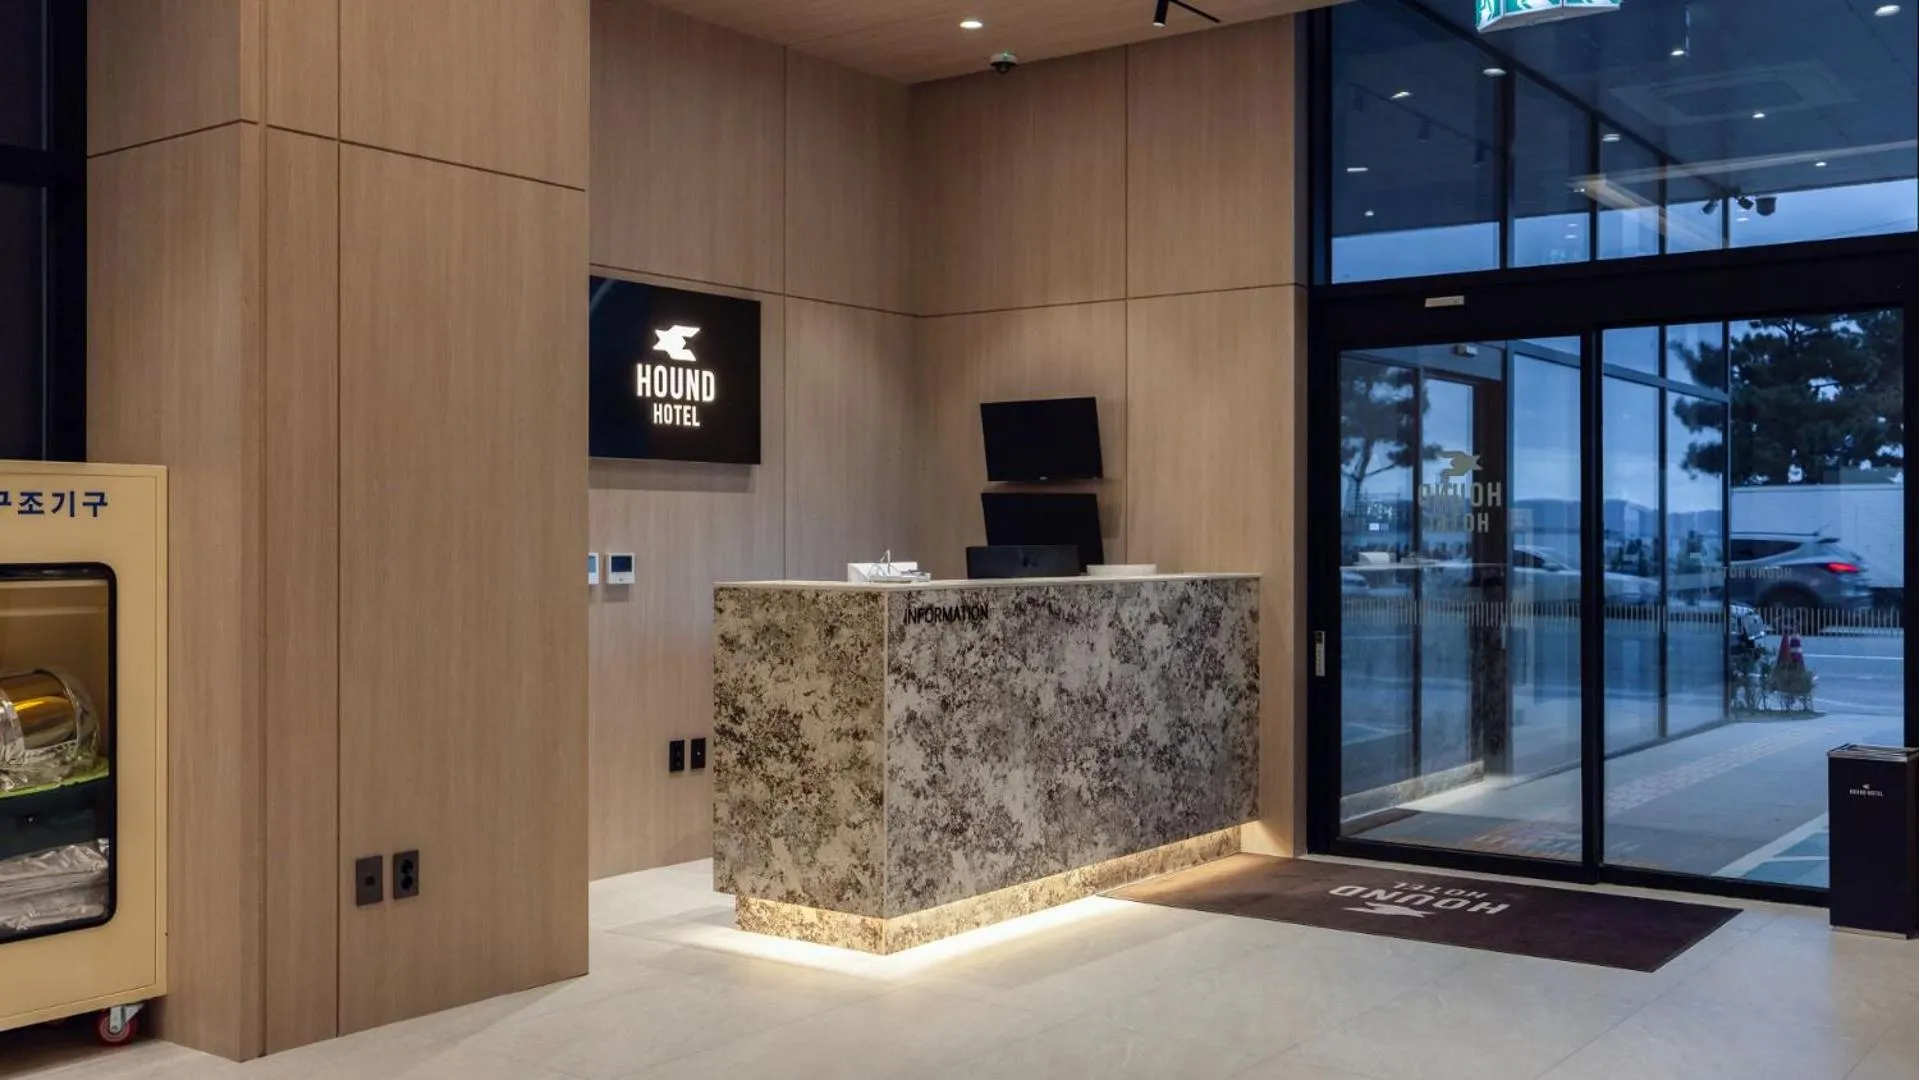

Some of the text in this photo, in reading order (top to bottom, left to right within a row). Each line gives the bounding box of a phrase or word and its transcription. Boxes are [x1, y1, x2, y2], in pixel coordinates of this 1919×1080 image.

[636, 363, 715, 402] HOUND
[653, 402, 700, 427] HOTEL
[903, 603, 989, 626] INFORMATION
[1328, 885, 1510, 915] HOUND
[1392, 881, 1488, 899] HOTEL
